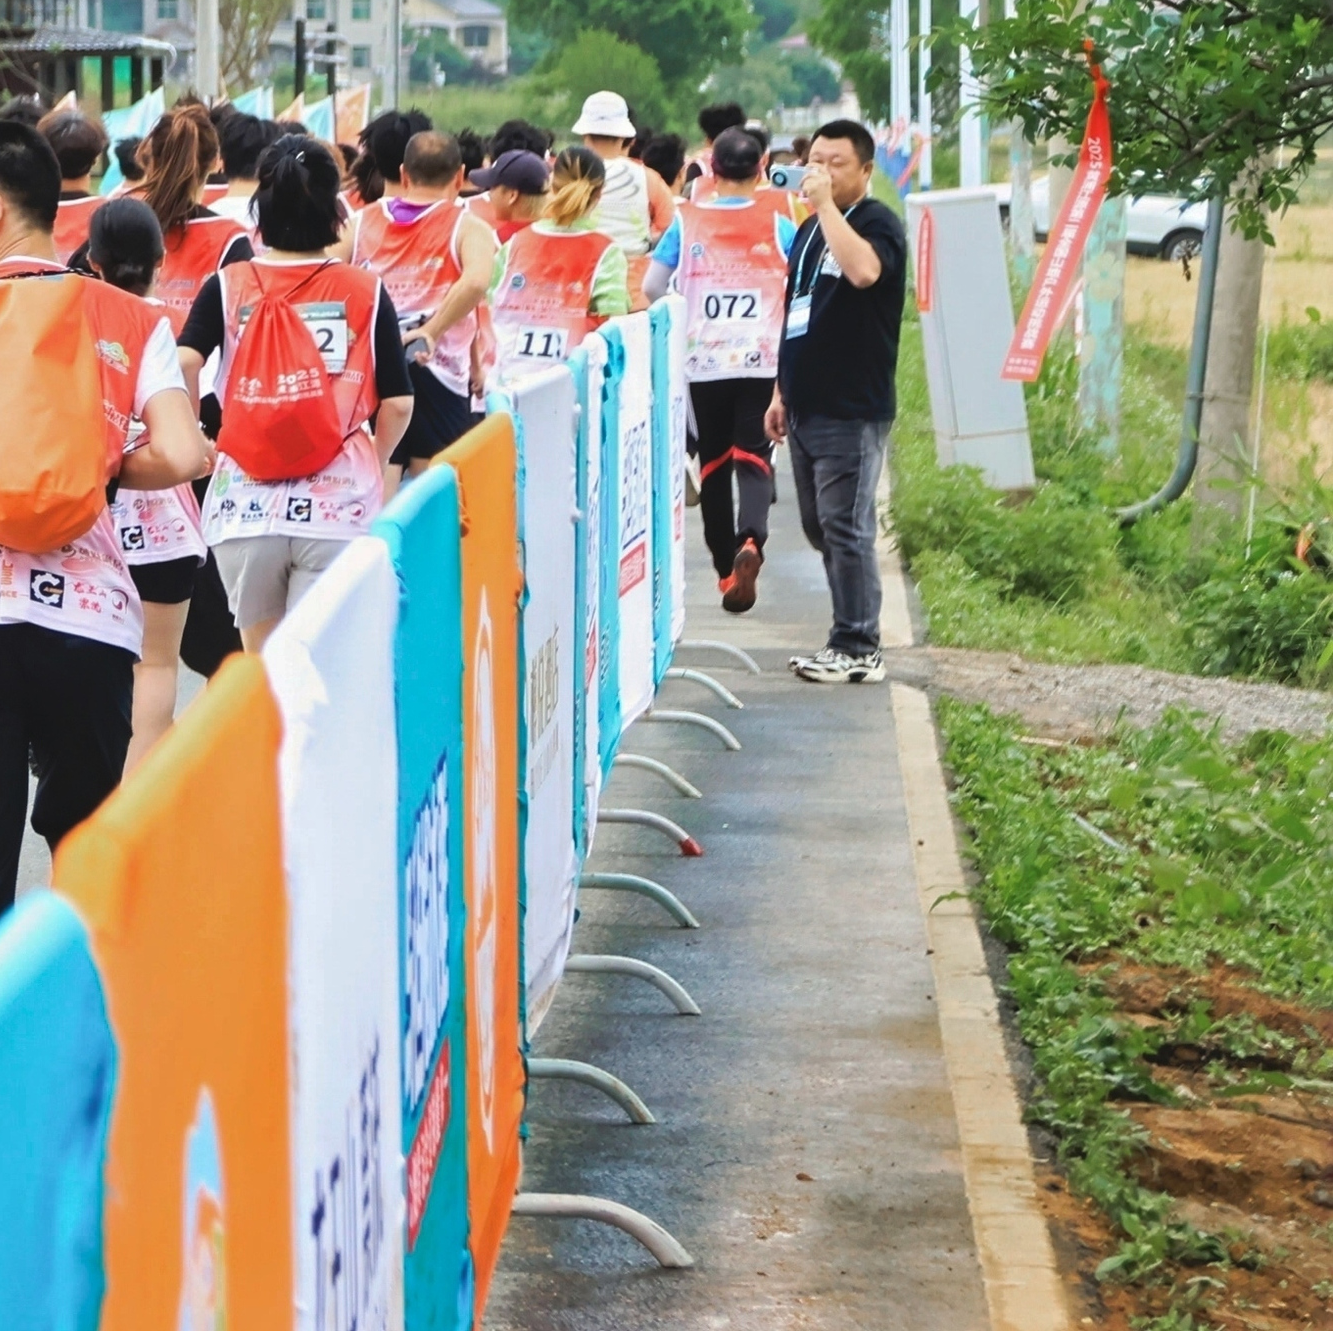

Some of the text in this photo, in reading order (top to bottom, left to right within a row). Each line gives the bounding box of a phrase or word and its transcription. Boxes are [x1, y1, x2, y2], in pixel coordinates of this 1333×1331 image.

[704, 294, 757, 319] 072
[316, 328, 335, 353] 2
[277, 367, 320, 385] 2025
